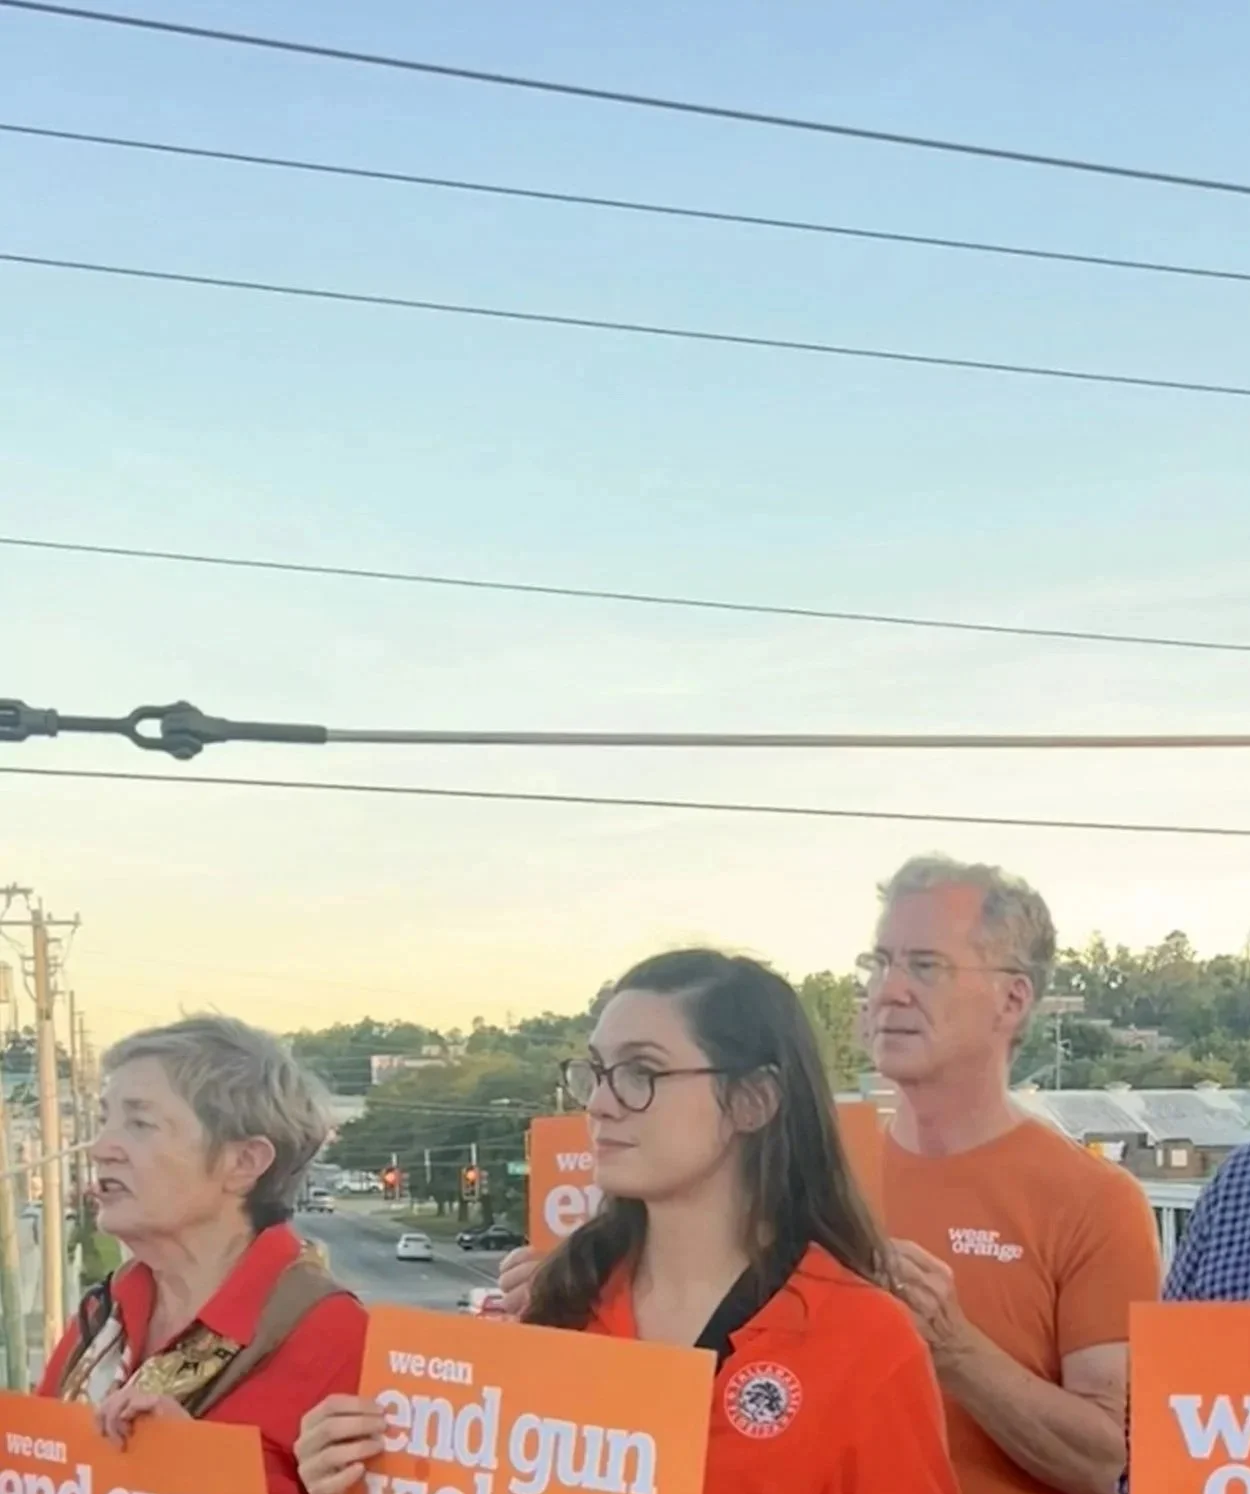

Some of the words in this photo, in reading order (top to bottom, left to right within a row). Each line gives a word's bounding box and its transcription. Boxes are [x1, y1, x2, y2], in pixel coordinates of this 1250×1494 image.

[555, 1151, 594, 1172] we
[389, 1350, 425, 1377] we
[428, 1356, 473, 1385] can
[376, 1386, 502, 1470] end
[5, 1431, 33, 1457] we
[34, 1438, 67, 1463] can
